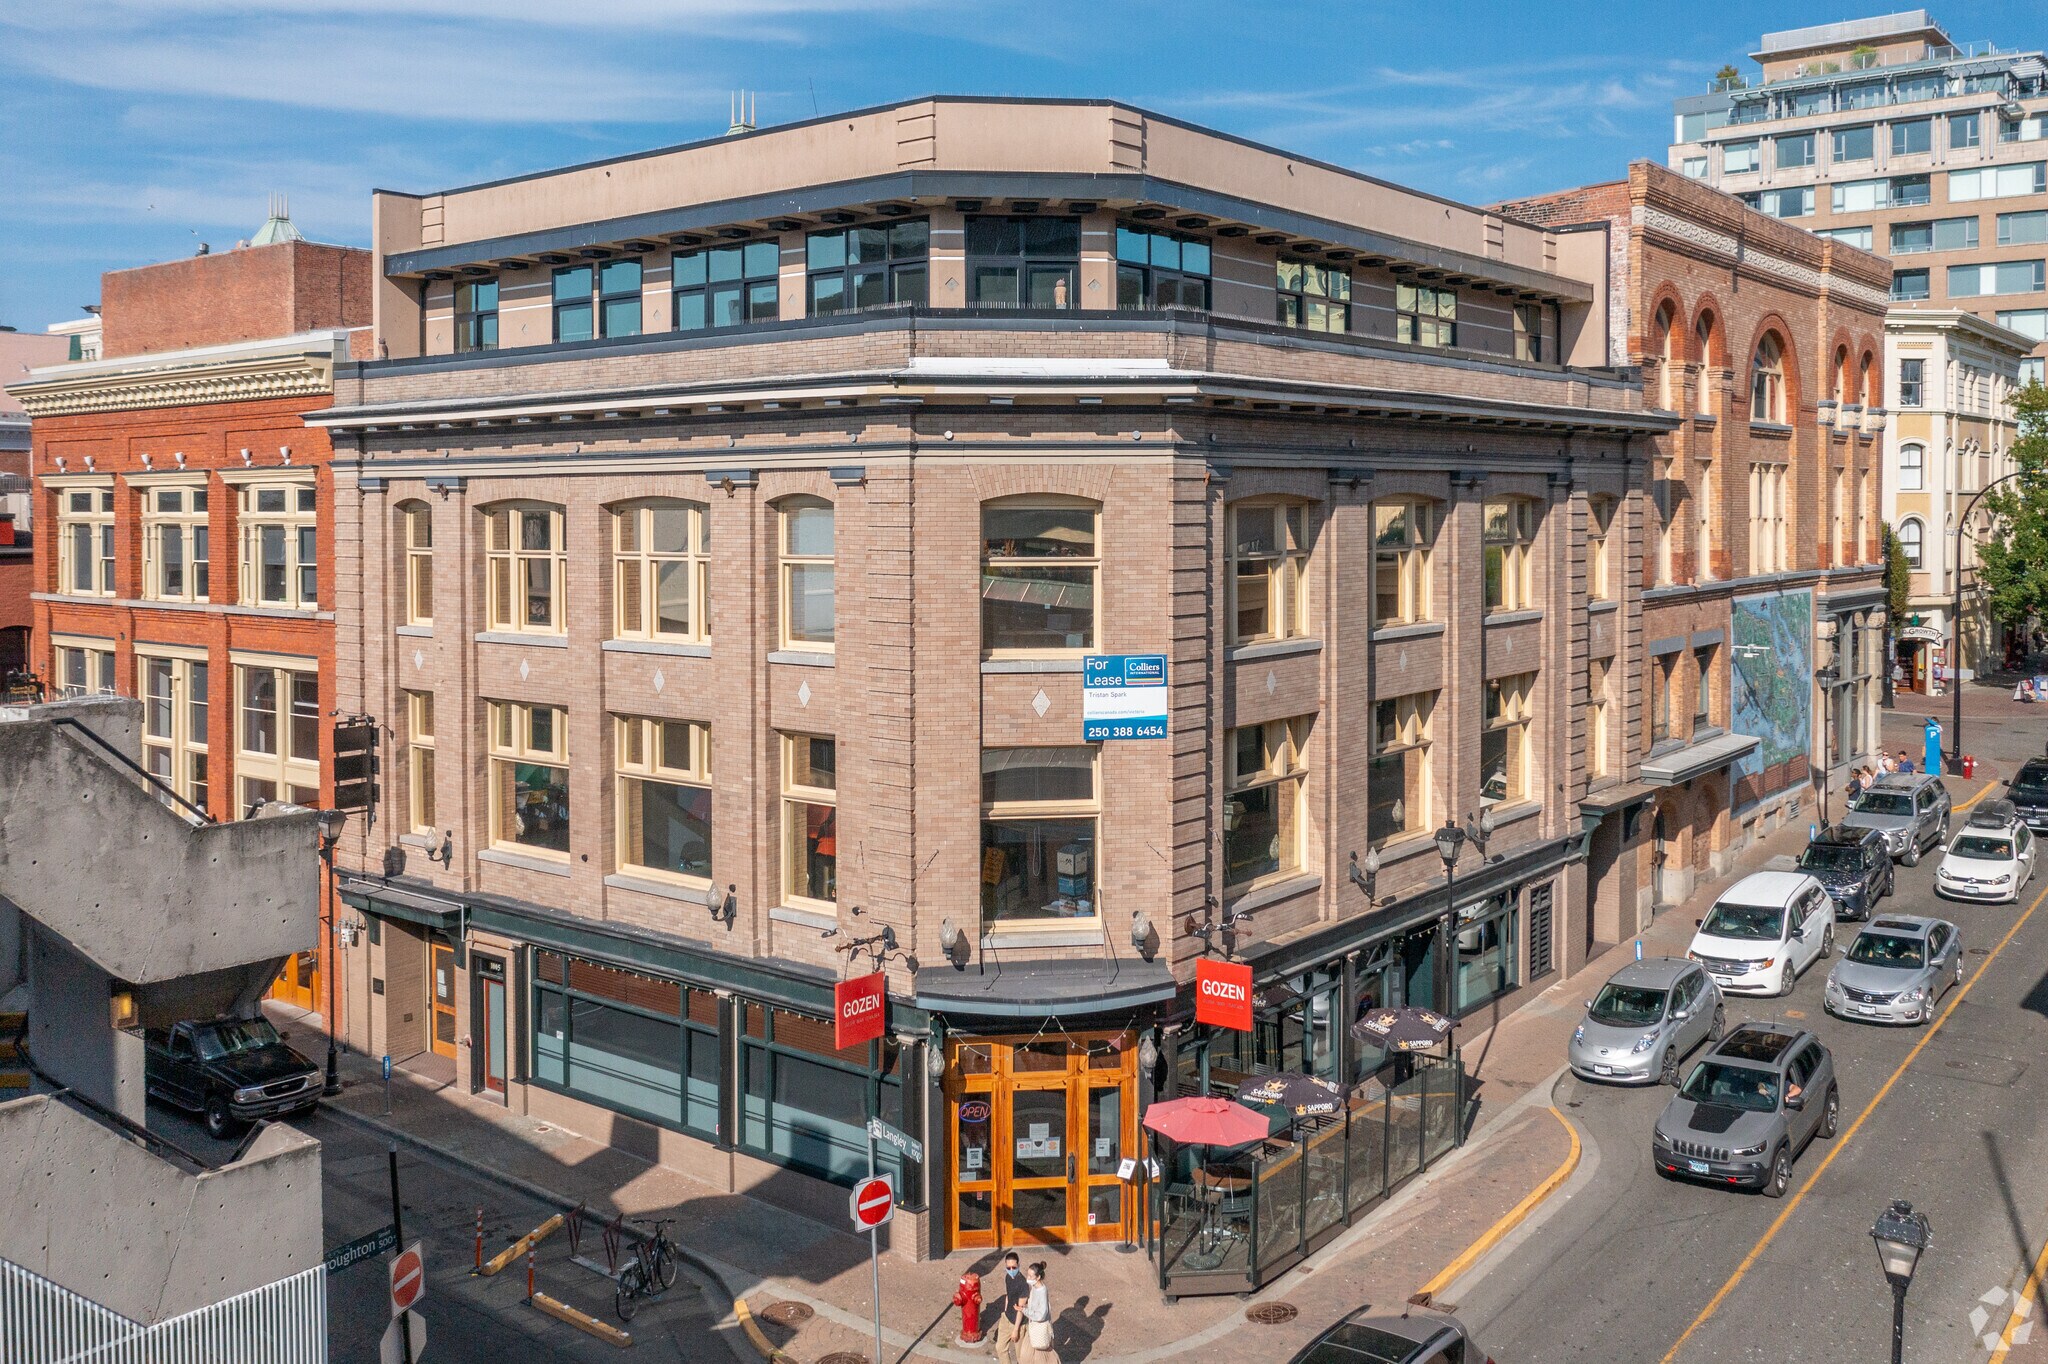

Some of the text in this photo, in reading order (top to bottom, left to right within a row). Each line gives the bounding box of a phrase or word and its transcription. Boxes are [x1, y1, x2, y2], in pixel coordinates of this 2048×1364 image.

[1086, 658, 1108, 670] For
[1129, 662, 1160, 671] Colliers
[1086, 674, 1122, 686] Lease
[1110, 691, 1127, 699] Spark
[1088, 725, 1163, 737] 250 388 6454
[1202, 979, 1245, 1001] GOZEN
[843, 993, 880, 1018] GOZEN
[960, 1106, 988, 1117] OPEN
[1307, 1102, 1333, 1112] SAPPORO
[883, 1125, 907, 1150] Langley
[326, 1241, 376, 1270] roughton
